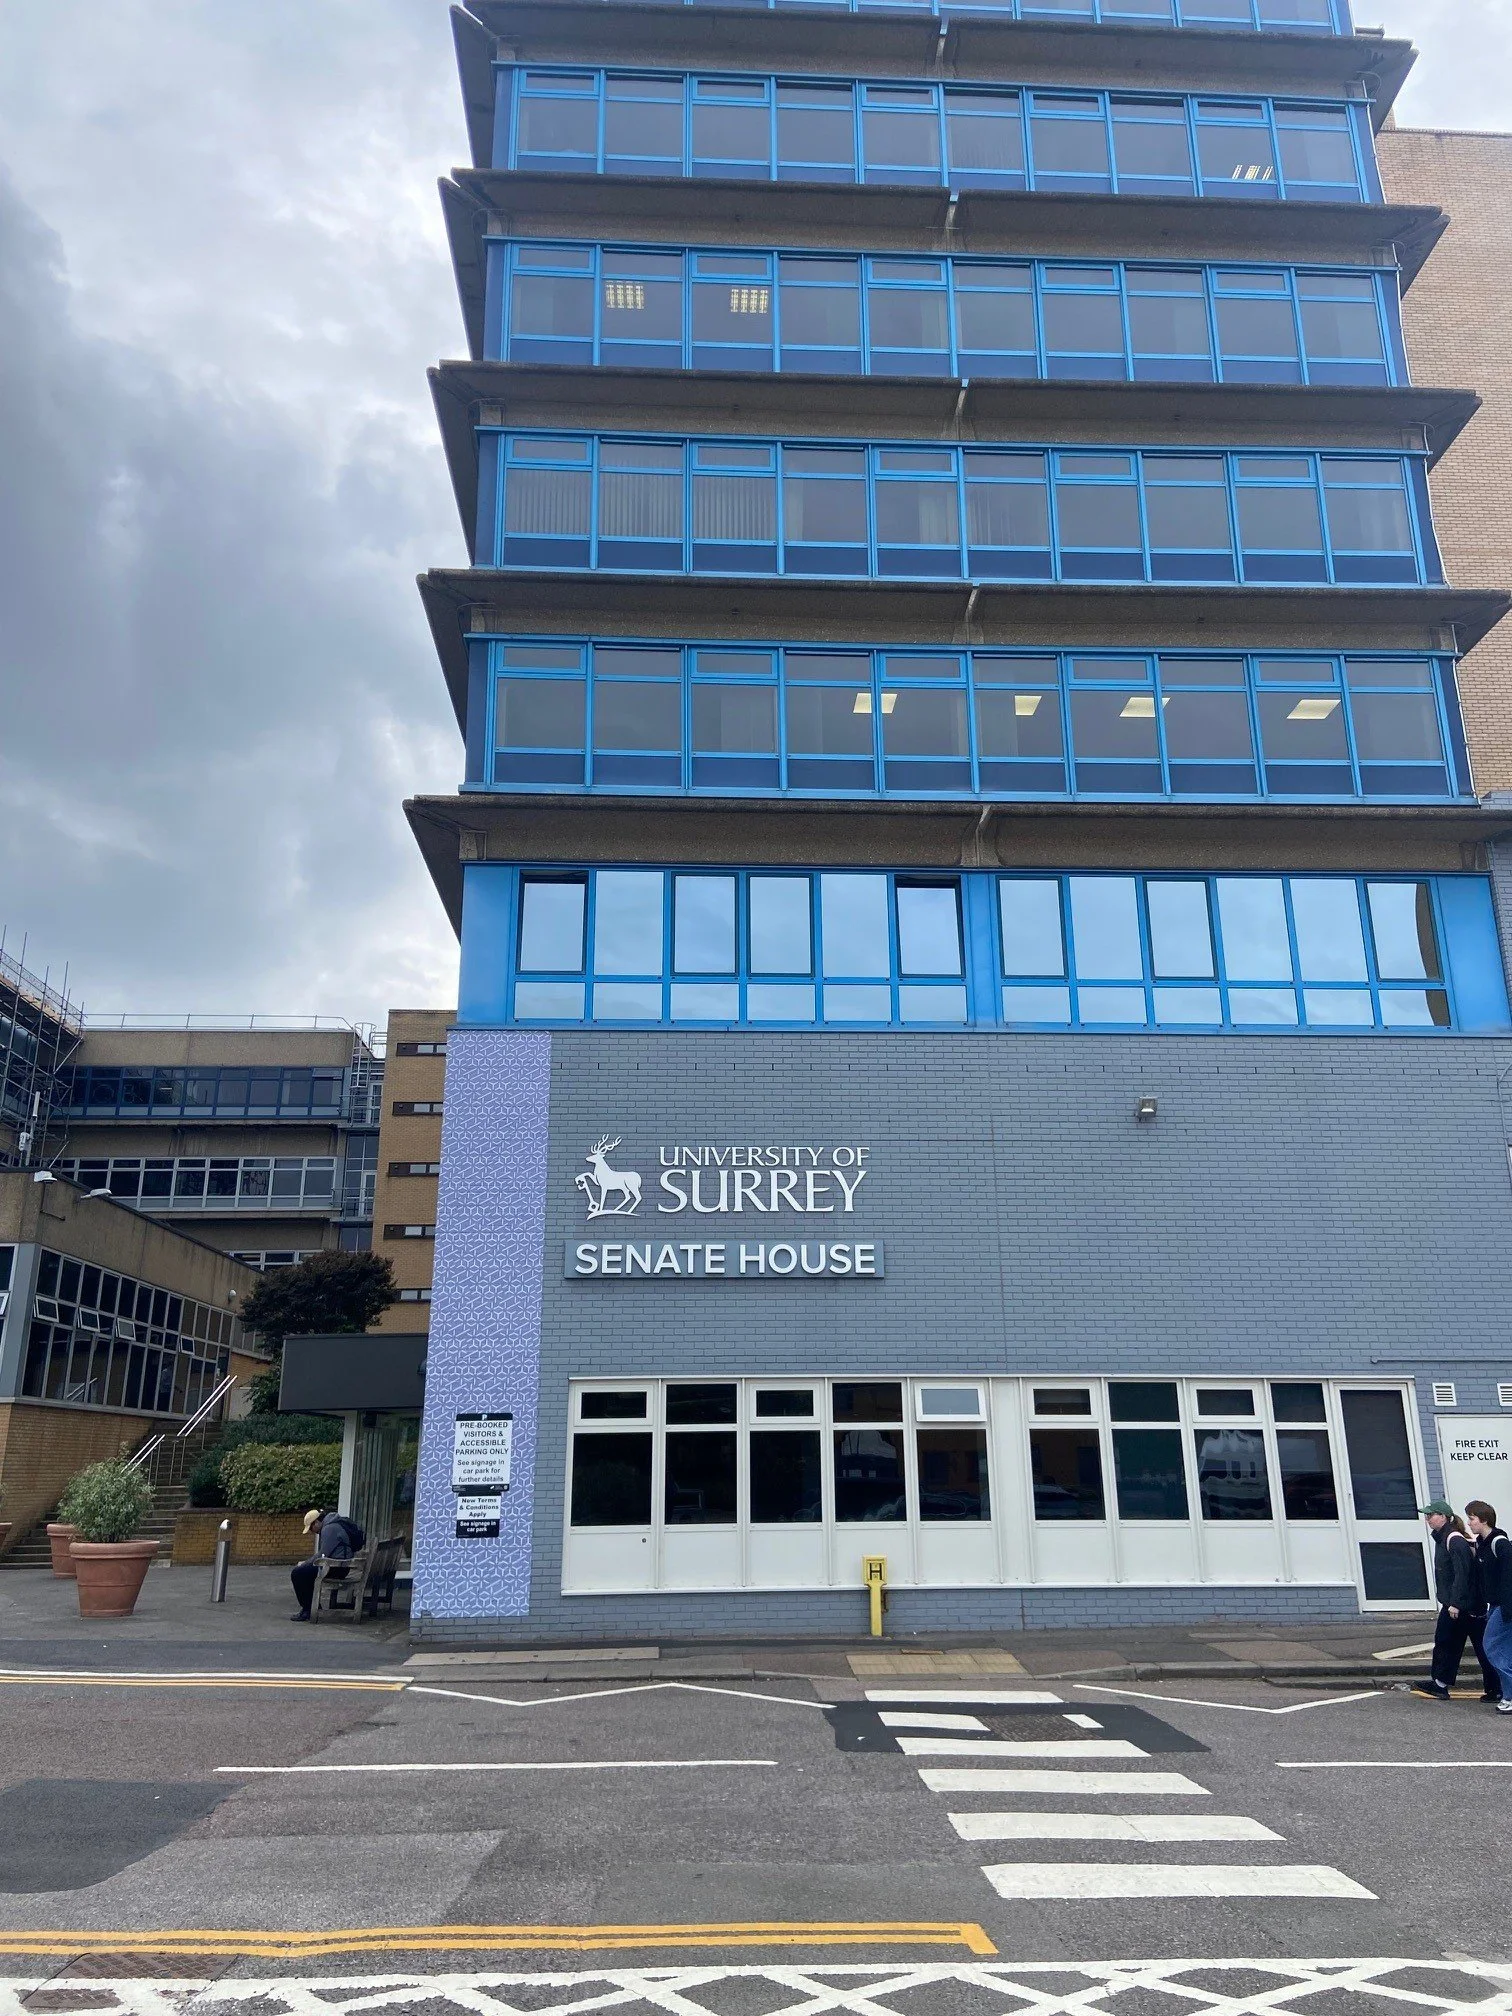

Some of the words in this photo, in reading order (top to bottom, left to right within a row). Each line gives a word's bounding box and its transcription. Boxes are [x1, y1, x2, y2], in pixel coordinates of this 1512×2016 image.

[659, 1146, 827, 1166] UNIVERSITY
[832, 1146, 870, 1167] OF
[657, 1169, 868, 1213] SURREY
[574, 1243, 726, 1274] SENATE
[739, 1243, 876, 1274] HOUSE
[1455, 1439, 1476, 1448] FIRE
[1478, 1439, 1499, 1448] EXIT
[471, 1459, 497, 1467] signage
[1450, 1452, 1475, 1461] KEEP
[1477, 1452, 1508, 1461] CLEAR
[474, 1467, 490, 1475] park
[870, 1563, 882, 1580] H
